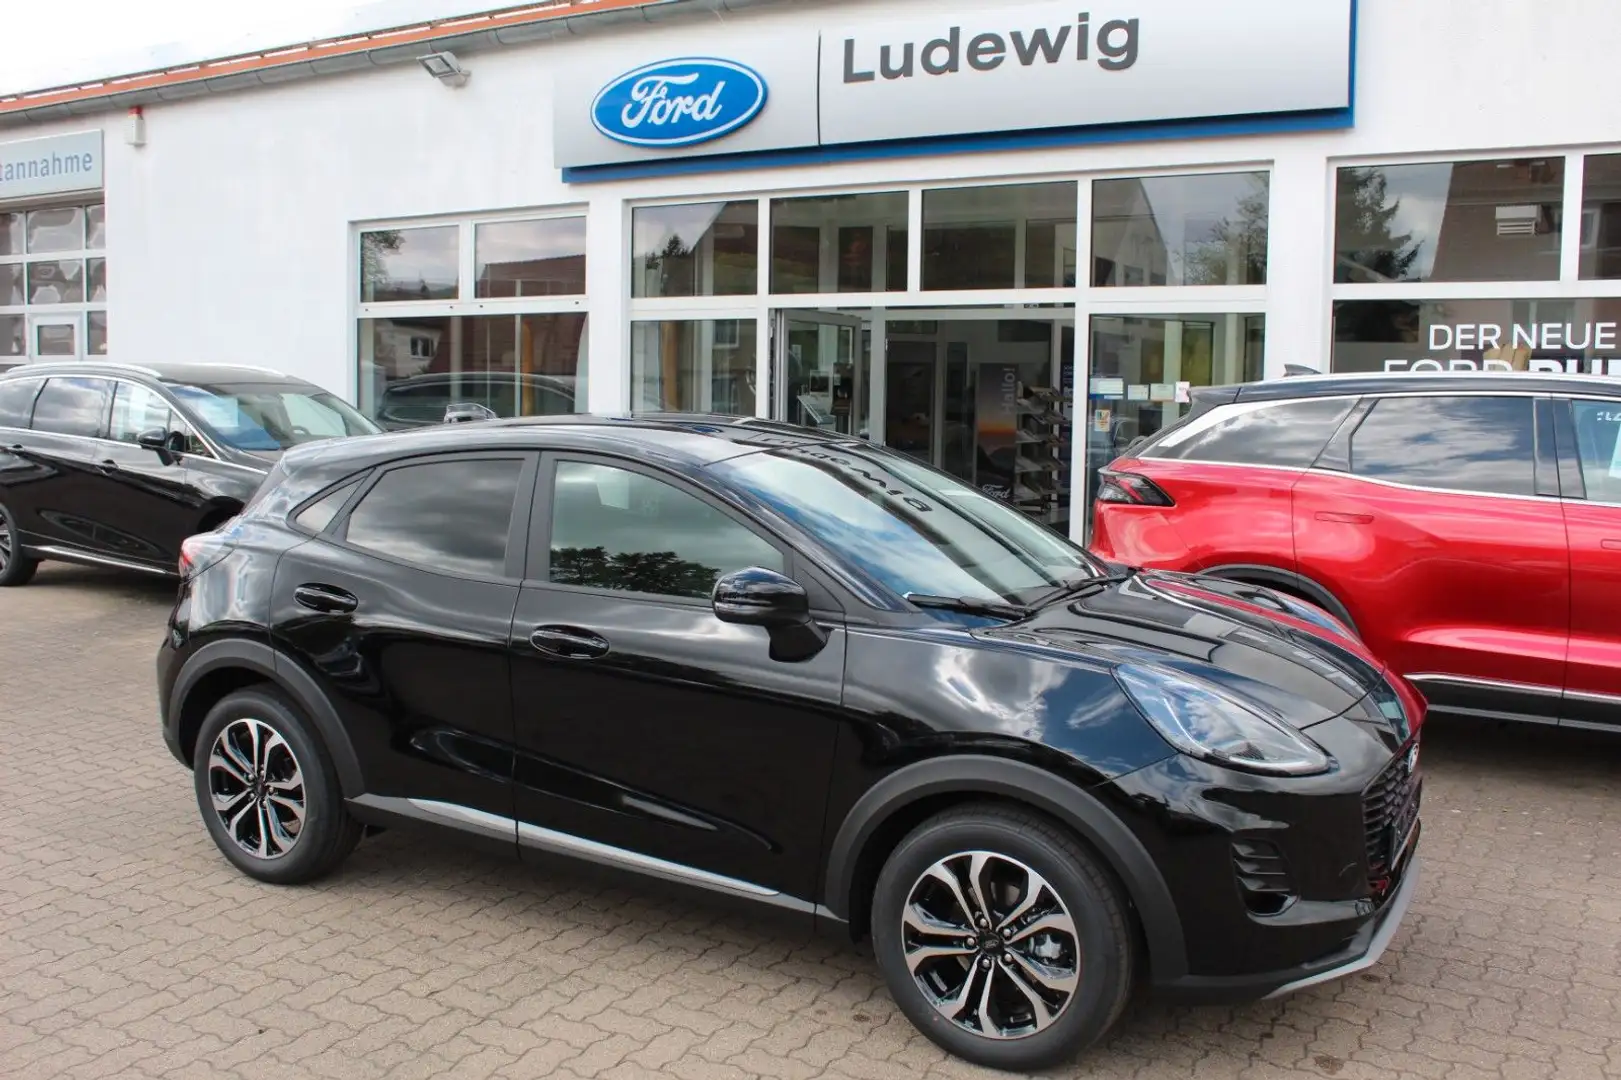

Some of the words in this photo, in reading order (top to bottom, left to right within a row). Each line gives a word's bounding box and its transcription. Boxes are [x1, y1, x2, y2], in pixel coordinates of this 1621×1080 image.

[843, 11, 1140, 84] Ludewig
[621, 72, 726, 129] Ford
[1429, 323, 1502, 350] DER
[1512, 322, 1617, 350] NEUE
[1001, 367, 1016, 415] Hallo!
